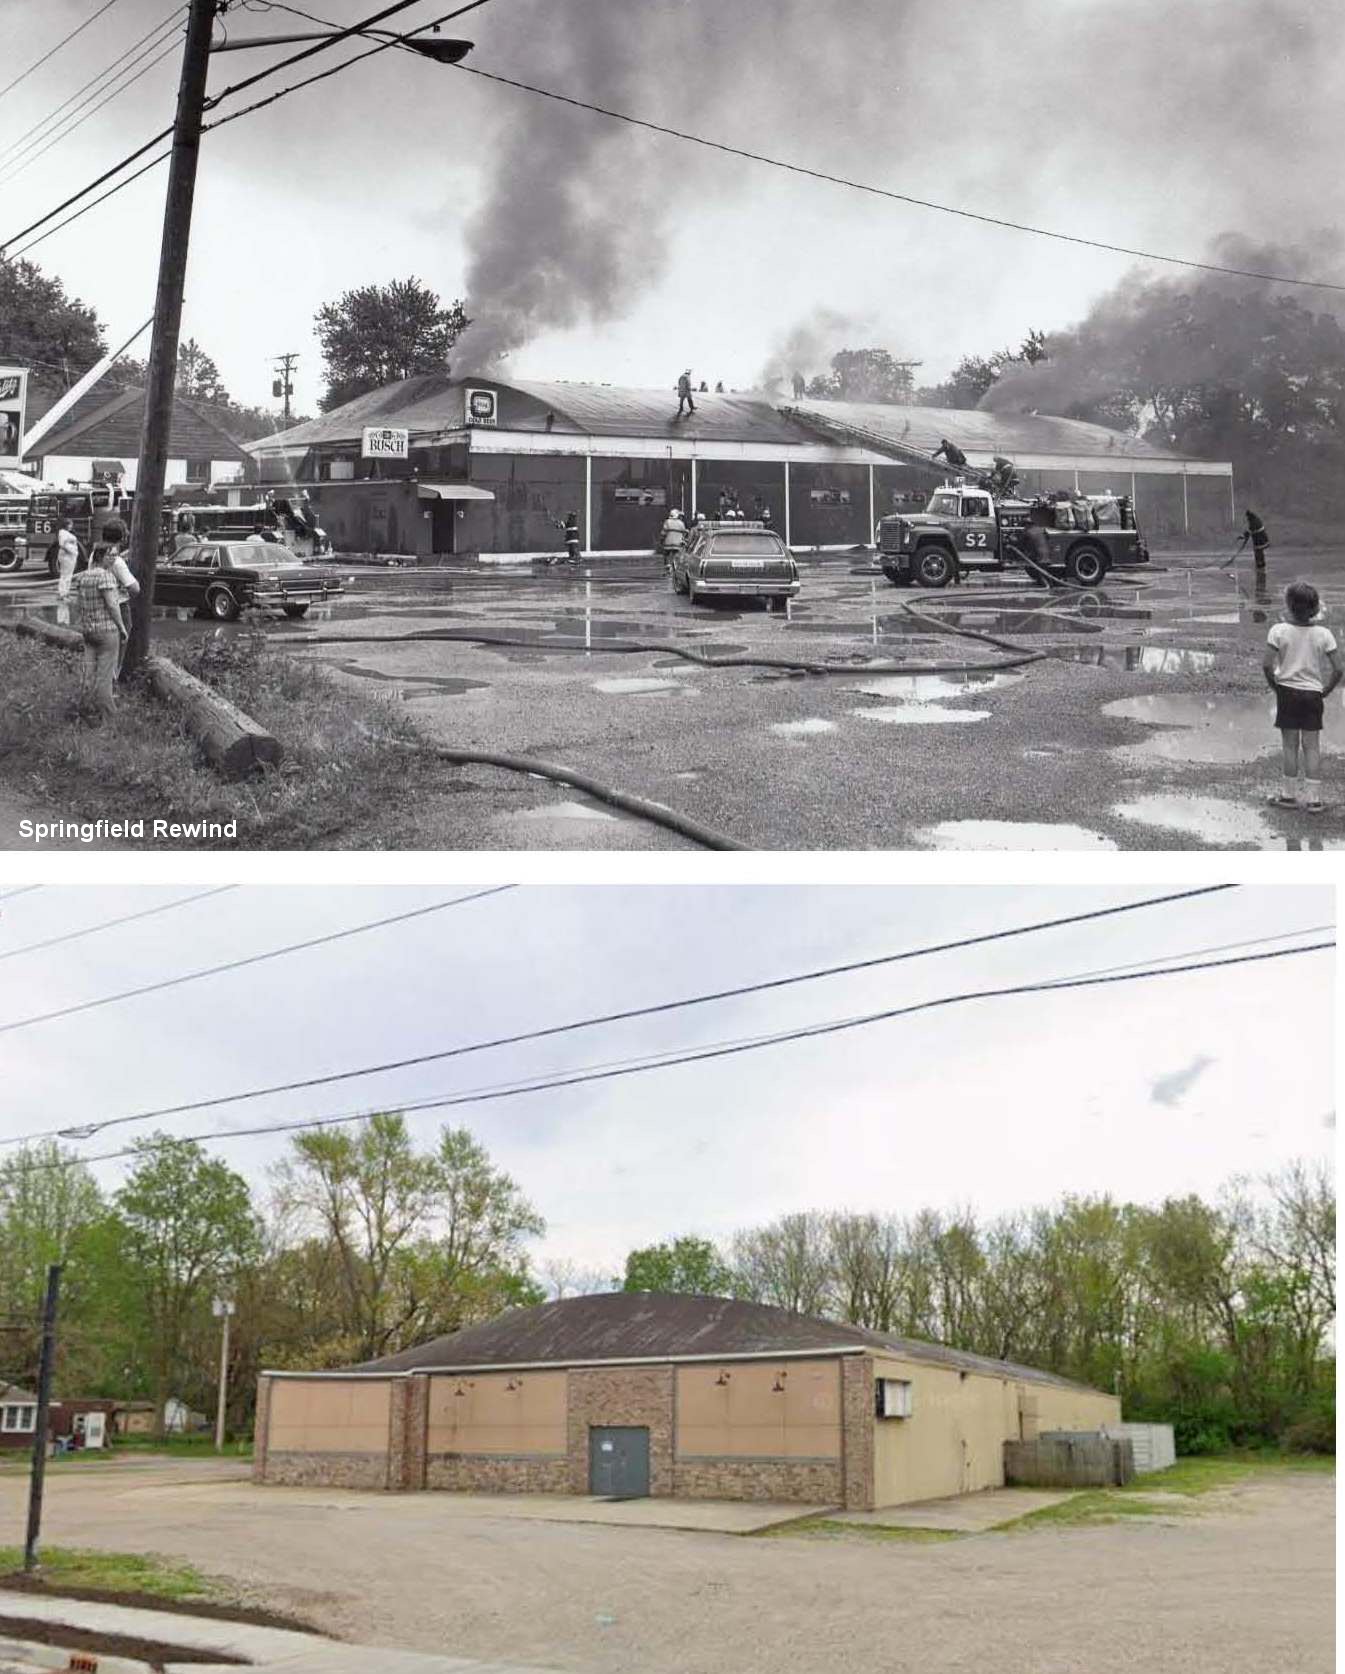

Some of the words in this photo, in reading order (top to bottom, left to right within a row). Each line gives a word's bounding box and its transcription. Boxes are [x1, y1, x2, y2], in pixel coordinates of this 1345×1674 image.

[370, 438, 405, 452] BUSCH
[34, 520, 51, 534] E6
[966, 533, 986, 547] S2
